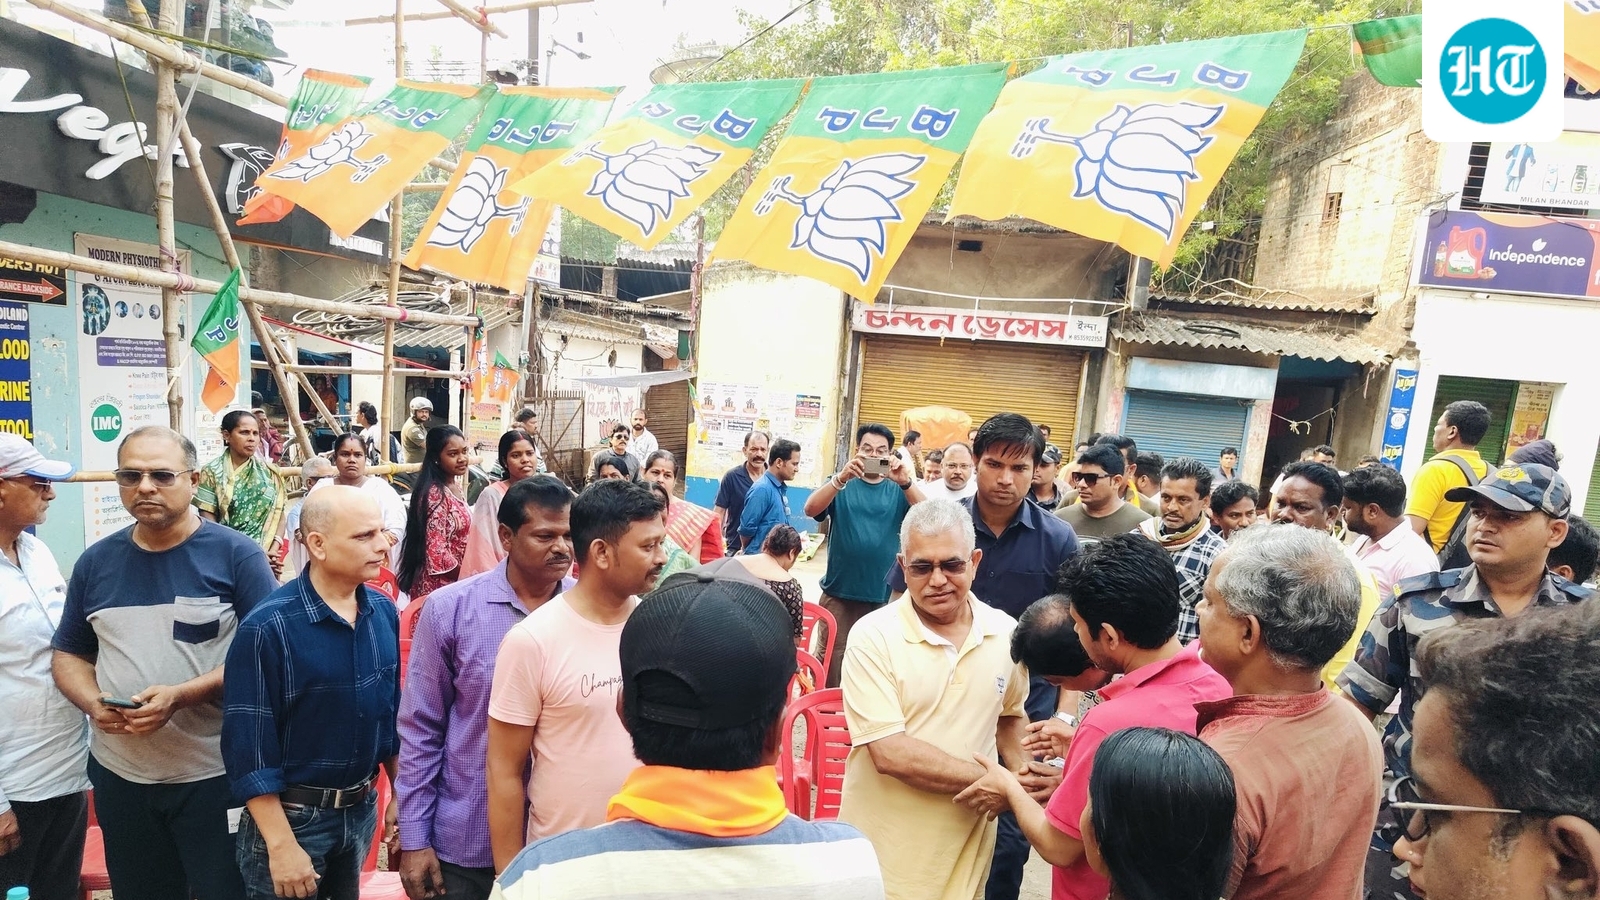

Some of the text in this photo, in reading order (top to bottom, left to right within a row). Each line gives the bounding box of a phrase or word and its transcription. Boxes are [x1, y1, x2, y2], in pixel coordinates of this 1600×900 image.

[819, 104, 959, 140] BJP
[1520, 196, 1590, 206] MILAN BHANDAR
[88, 248, 121, 263] MODERN
[1489, 246, 1586, 267] Independence
[23, 284, 53, 295] BACKSIDE
[865, 310, 957, 332] চন্দন
[93, 416, 121, 431] IMC
